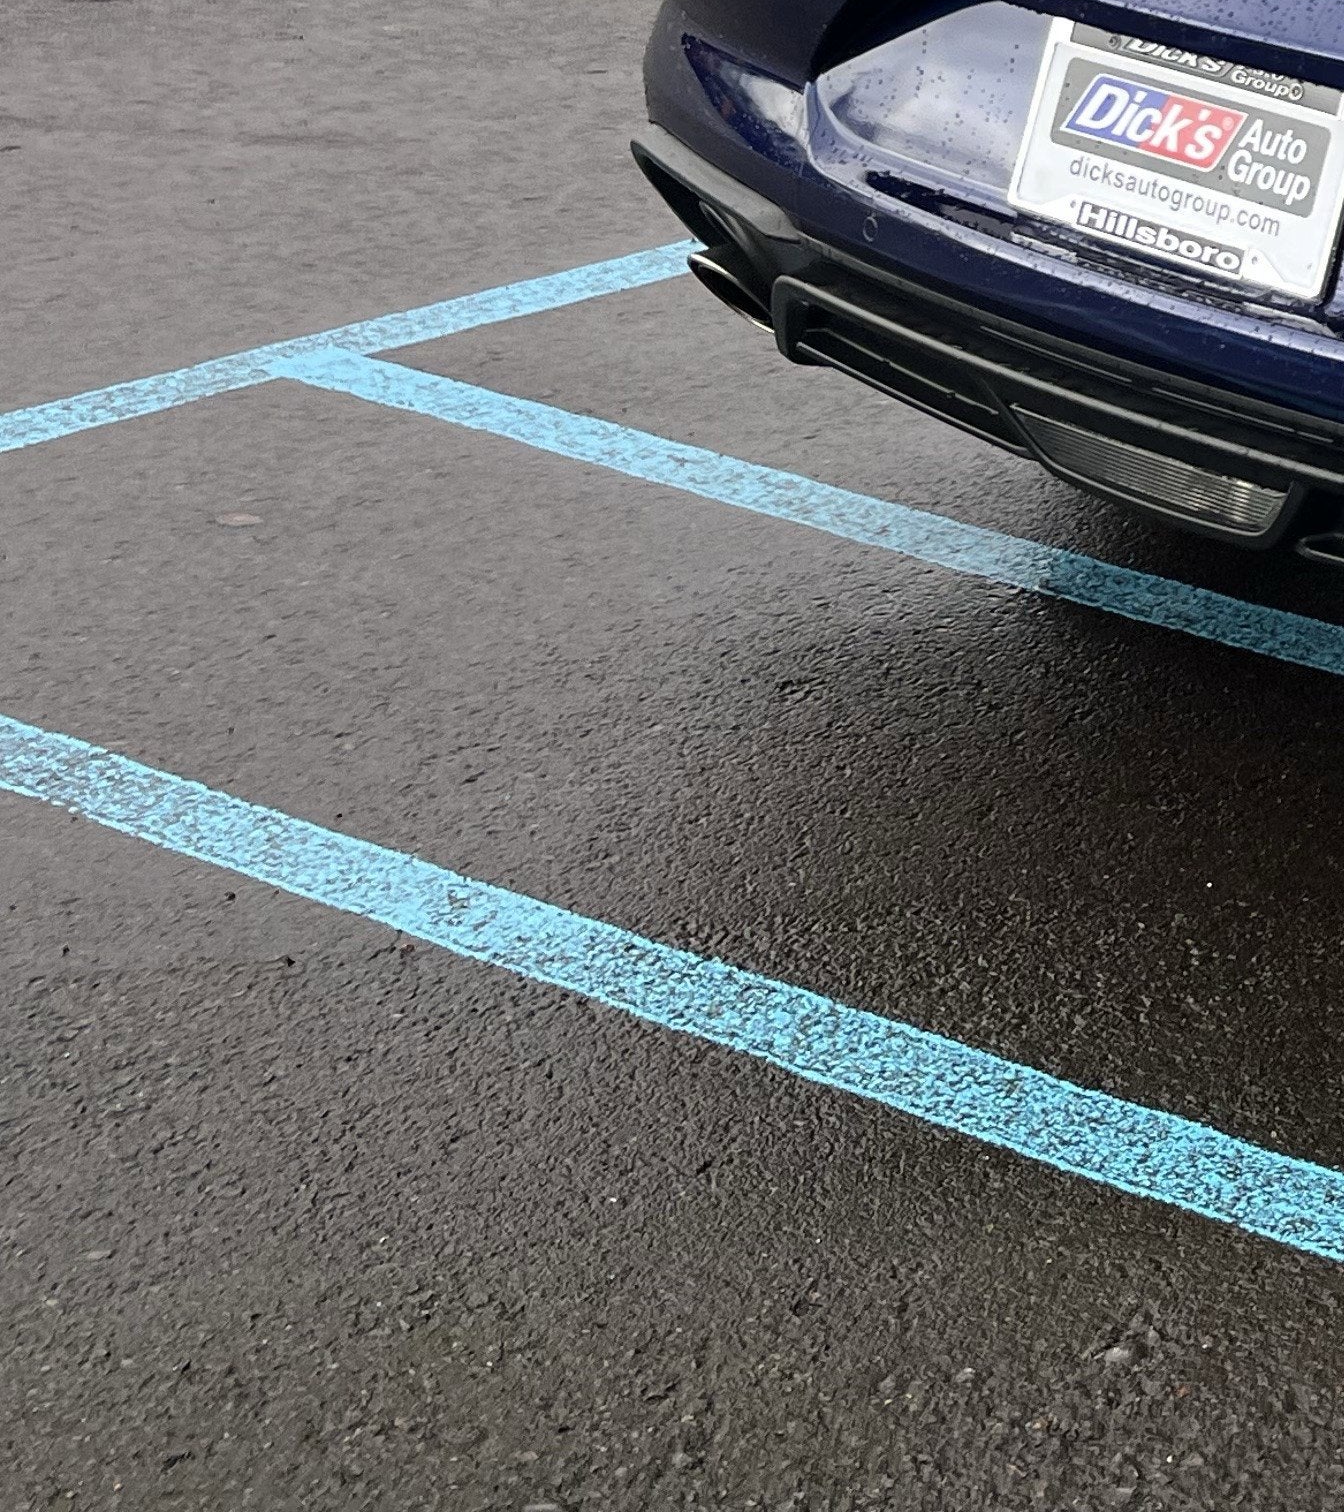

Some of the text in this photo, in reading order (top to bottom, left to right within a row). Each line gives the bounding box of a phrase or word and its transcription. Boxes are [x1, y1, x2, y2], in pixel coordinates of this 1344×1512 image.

[1231, 70, 1291, 98] Group
[1075, 83, 1223, 160] Dick's
[1238, 118, 1308, 165] Auto
[1069, 155, 1281, 237] dicksautogroup.com
[1227, 149, 1312, 206] Group
[1077, 202, 1241, 271] Hillsboro
